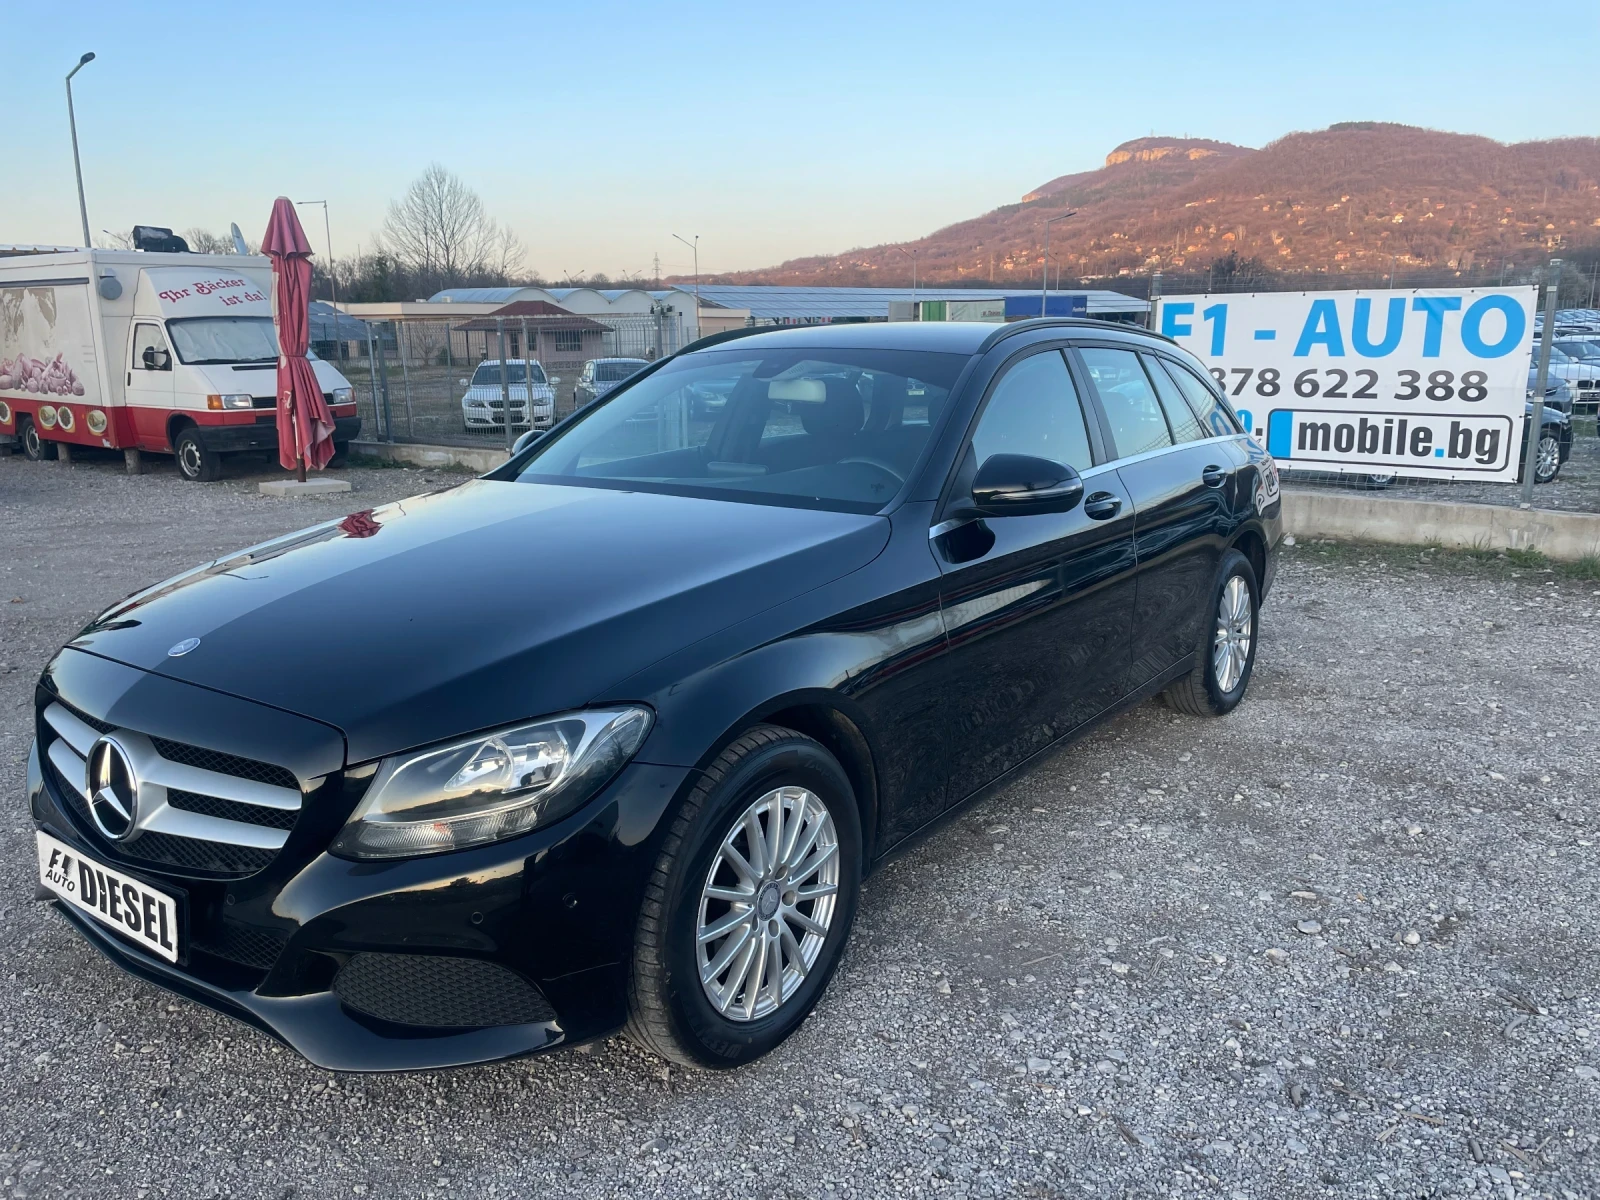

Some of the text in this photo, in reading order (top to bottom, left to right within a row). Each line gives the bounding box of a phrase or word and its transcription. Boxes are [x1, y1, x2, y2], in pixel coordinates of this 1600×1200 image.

[158, 278, 246, 303] Ihr Bäcker
[219, 290, 267, 306] ist da!
[1162, 294, 1526, 358] F1 - AUTO
[1294, 369, 1379, 399] 622
[1393, 369, 1489, 402] 388
[1297, 417, 1501, 465] mobile.bg
[45, 869, 75, 892] AUTO
[78, 859, 173, 952] DIESEL
